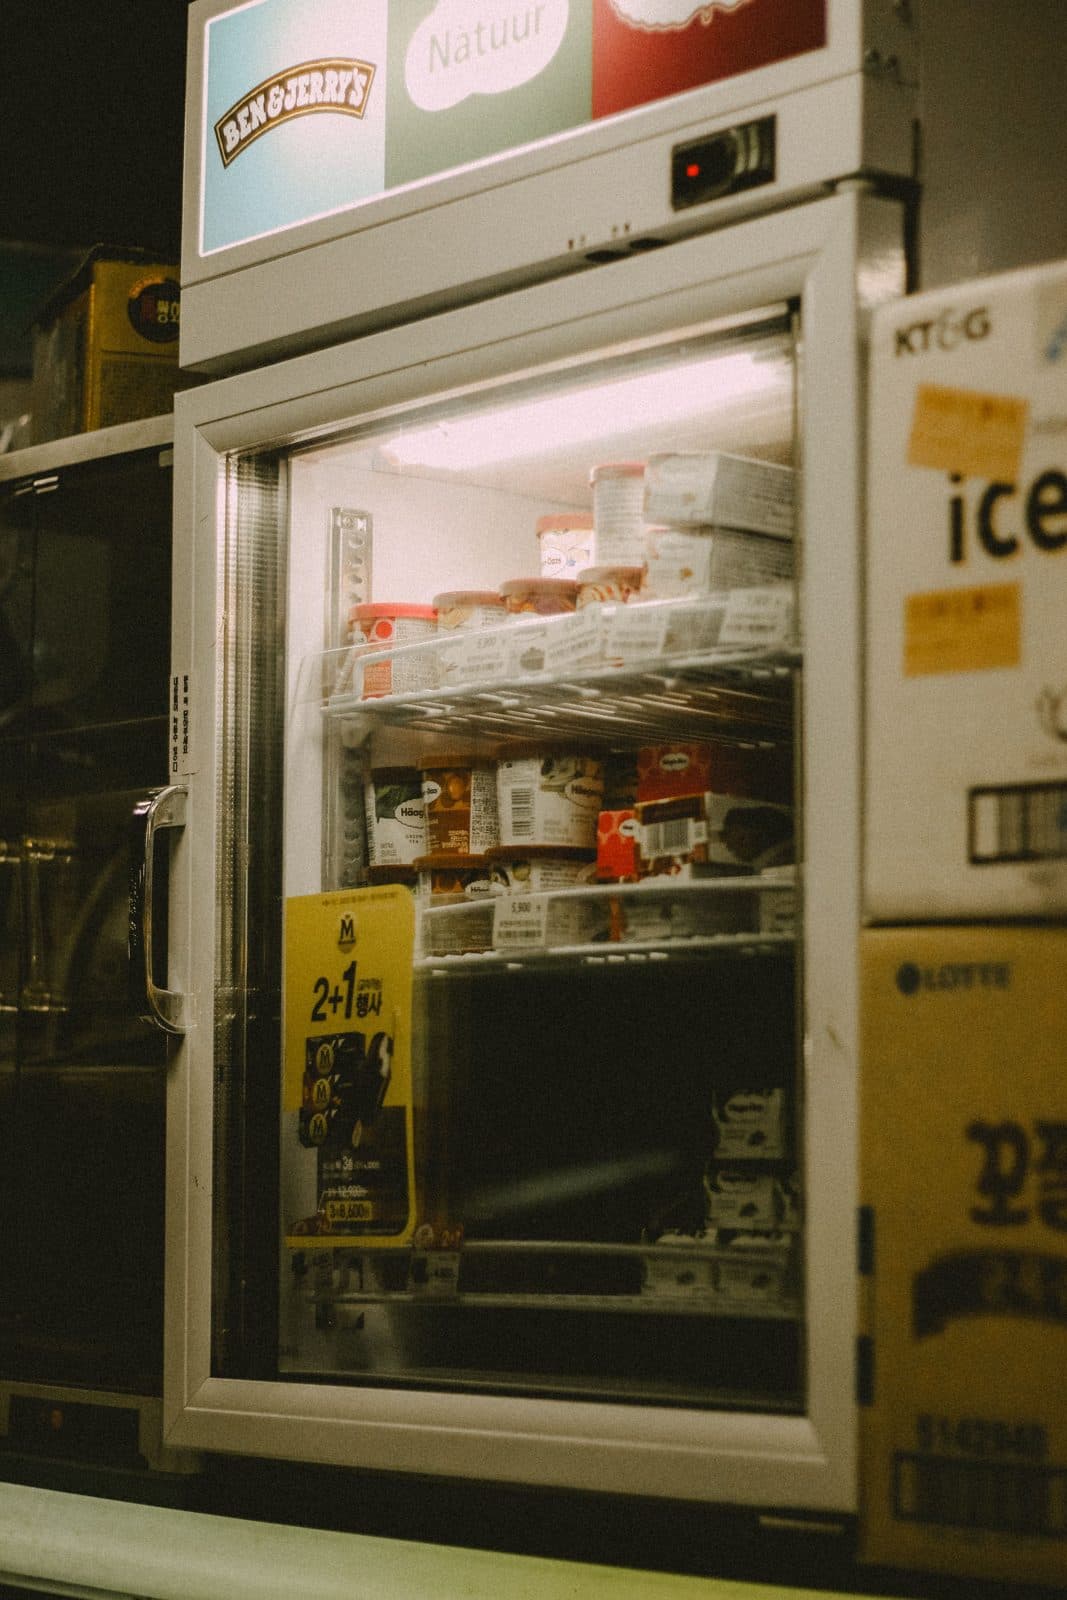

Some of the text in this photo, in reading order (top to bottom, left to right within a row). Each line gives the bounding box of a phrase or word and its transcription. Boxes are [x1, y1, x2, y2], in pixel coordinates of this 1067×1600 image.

[948, 466, 1067, 565] ice
[310, 961, 358, 1023] 2+1
[356, 991, 383, 1019] 행사
